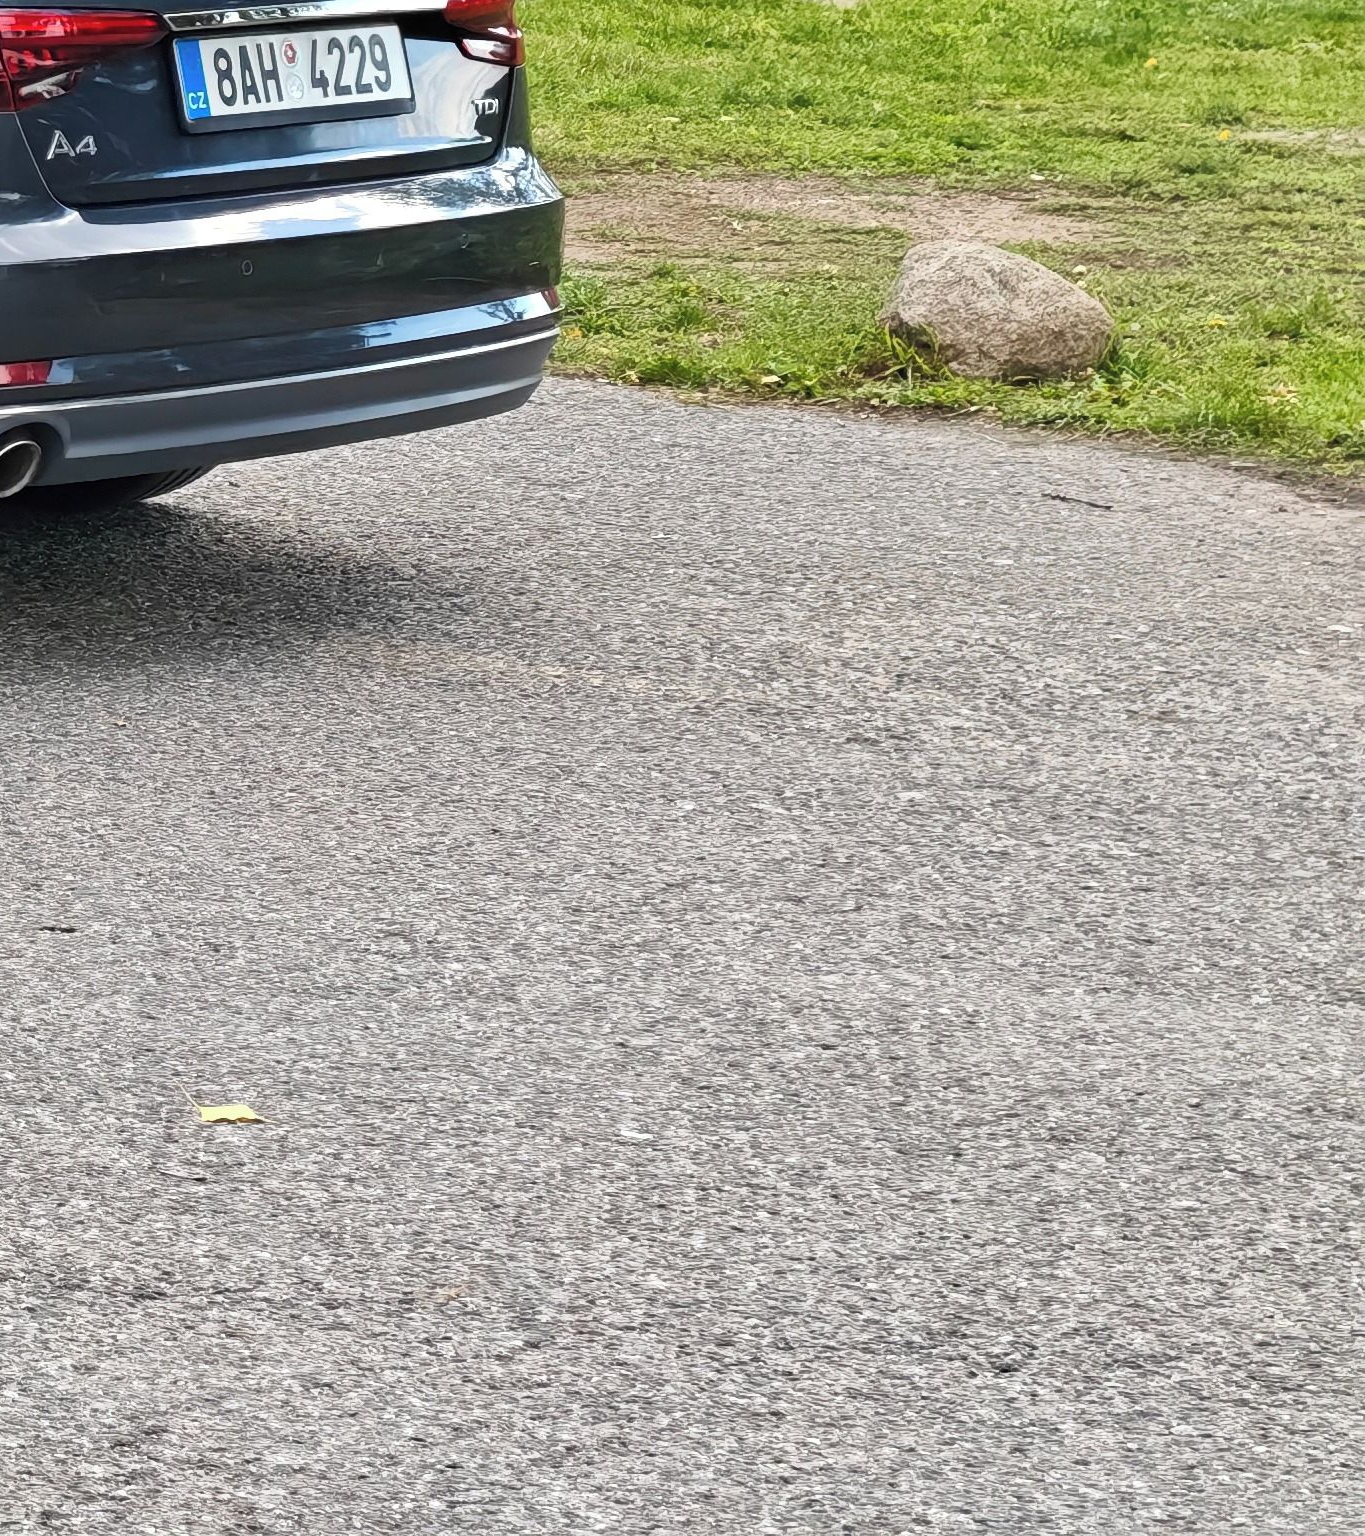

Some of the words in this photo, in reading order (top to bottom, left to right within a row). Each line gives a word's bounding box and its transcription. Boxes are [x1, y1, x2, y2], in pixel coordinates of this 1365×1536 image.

[213, 41, 284, 107] 8AH
[310, 33, 392, 98] 4229
[188, 91, 208, 110] CZ
[473, 98, 499, 116] TDI
[46, 129, 98, 161] A4
